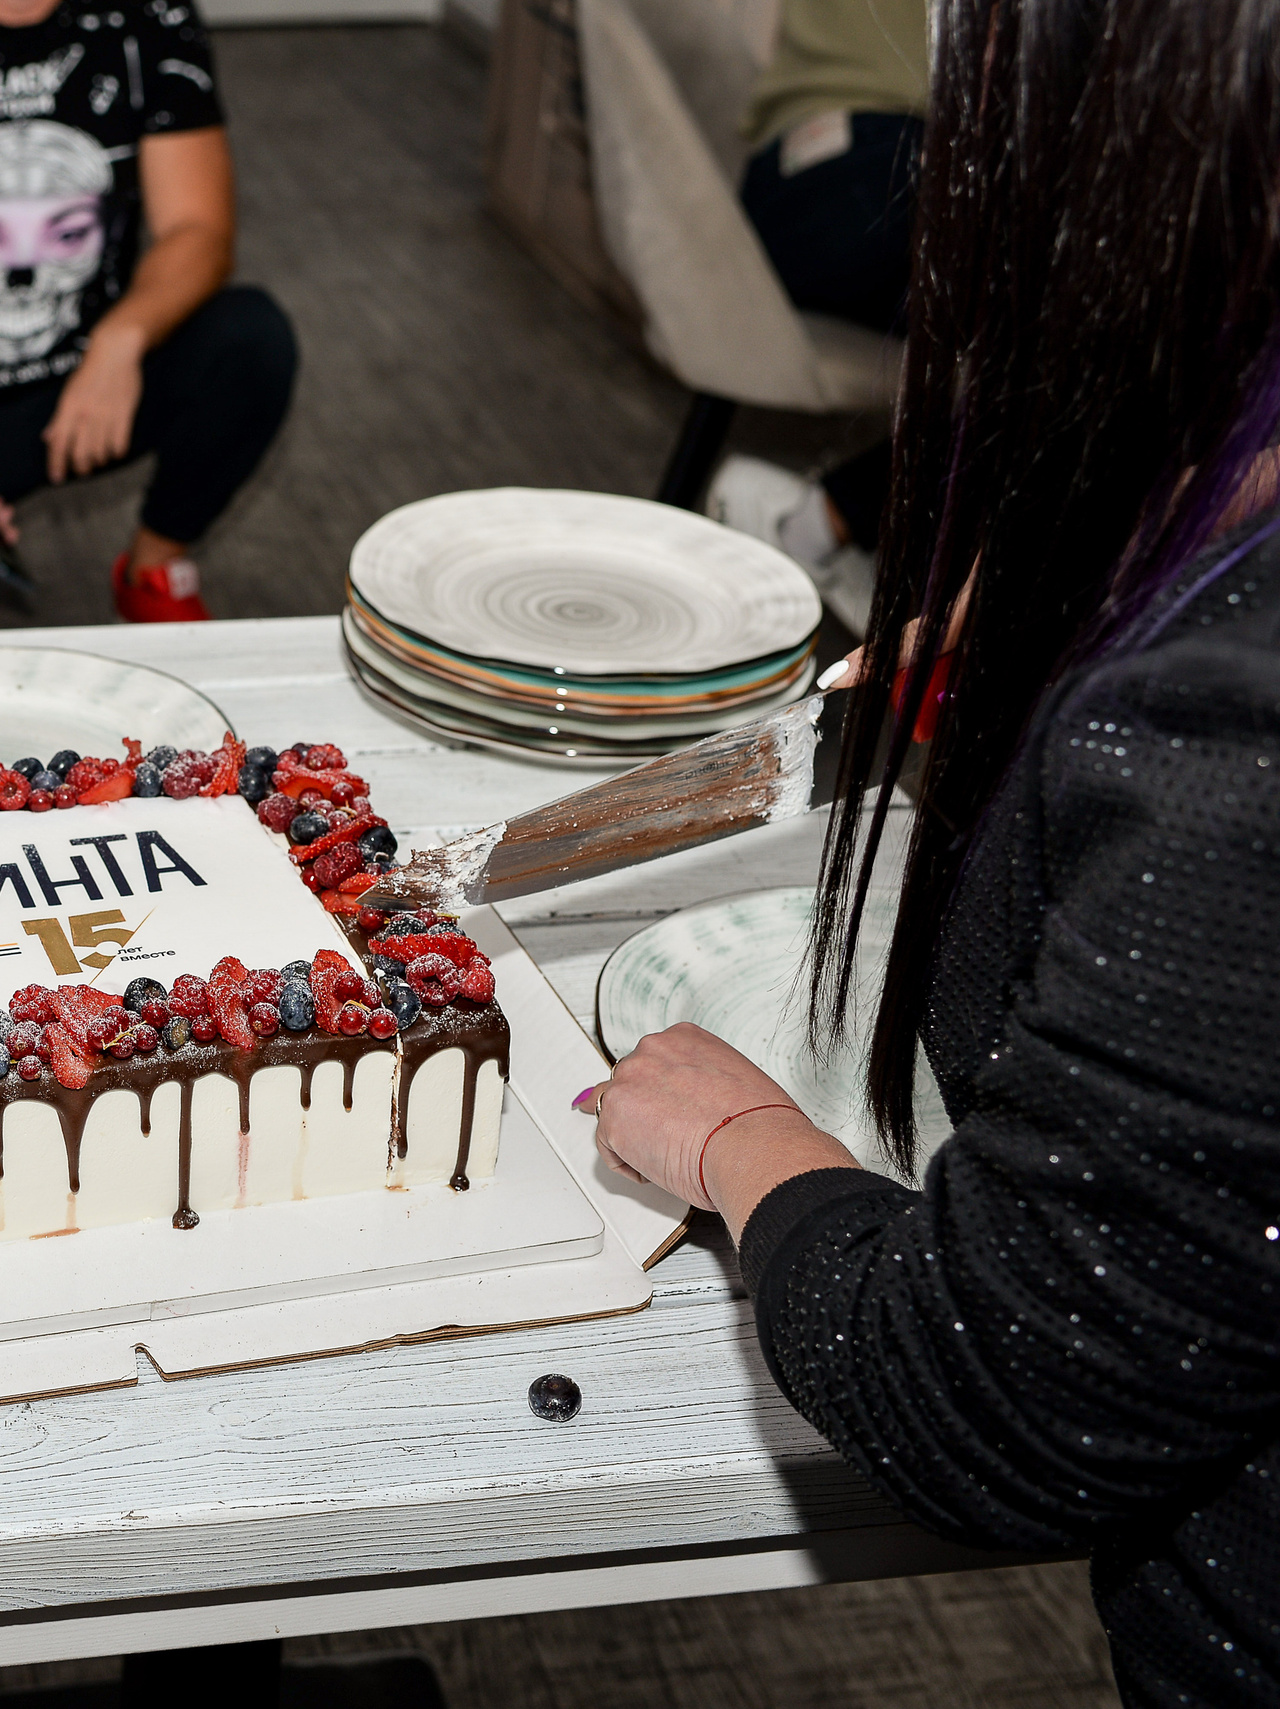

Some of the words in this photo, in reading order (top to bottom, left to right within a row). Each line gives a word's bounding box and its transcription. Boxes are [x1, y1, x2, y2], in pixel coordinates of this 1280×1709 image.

[21, 909, 135, 976] 15
[117, 946, 143, 955] лет
[120, 950, 176, 962] вместе
